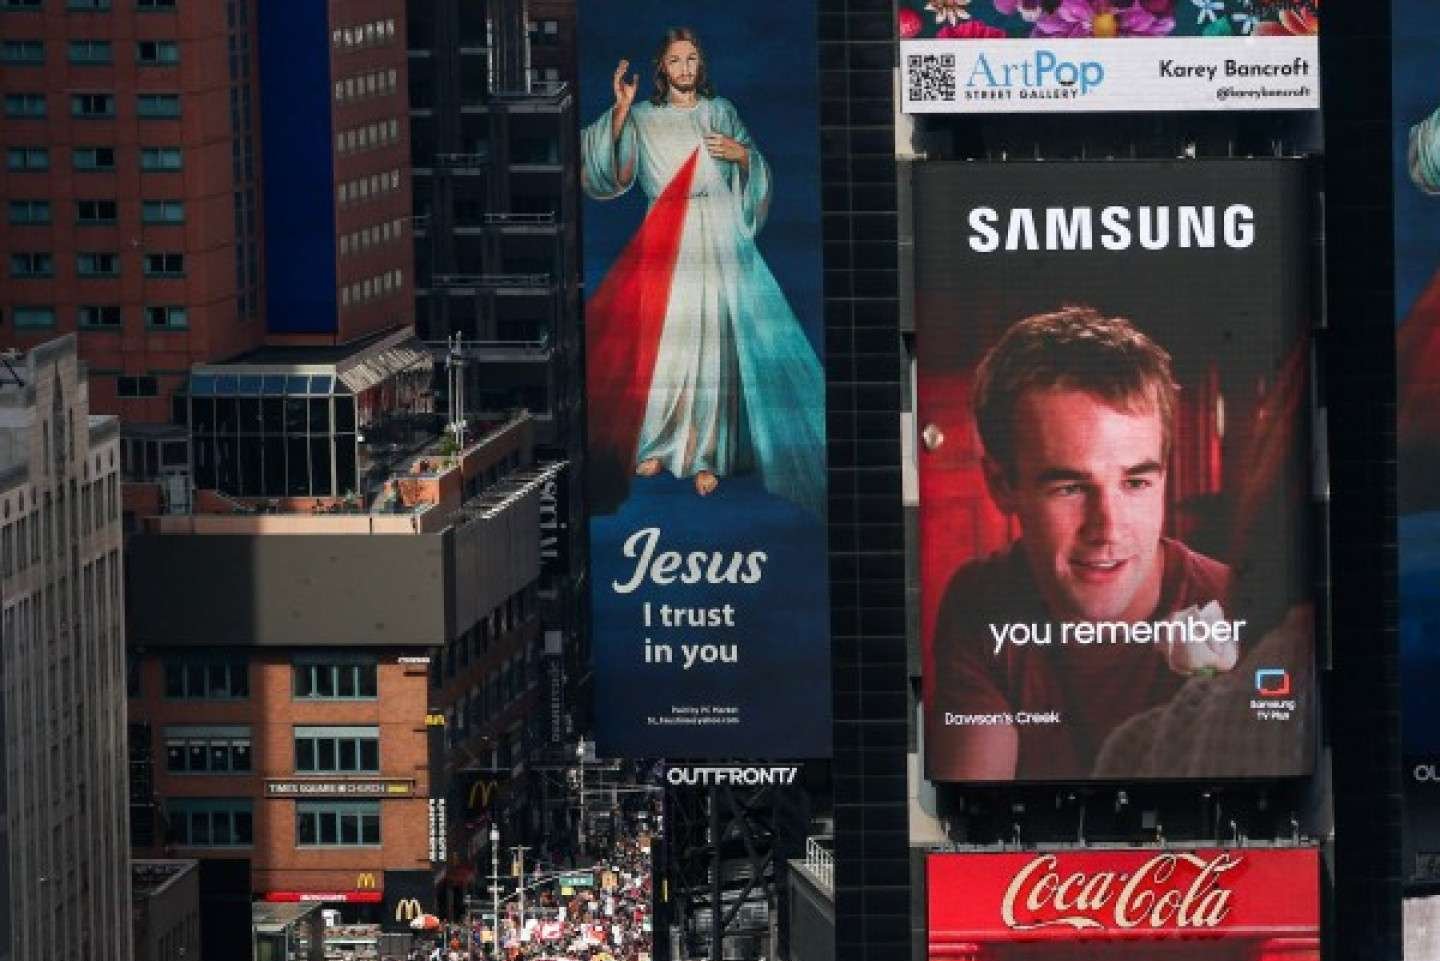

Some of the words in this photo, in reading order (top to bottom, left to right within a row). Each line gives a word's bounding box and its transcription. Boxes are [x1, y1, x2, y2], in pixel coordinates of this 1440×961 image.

[966, 50, 1104, 95] ArtPop
[1159, 60, 1217, 82] Karey
[1225, 58, 1309, 78] Bancroft
[965, 89, 1011, 100] STREET
[1019, 88, 1078, 100] GALLERY
[968, 203, 1255, 253] SAMSUNG
[612, 527, 768, 594] Jesus
[643, 602, 651, 628] I
[659, 604, 736, 628] trust
[989, 621, 1050, 654] you
[1060, 618, 1246, 646] remember
[645, 638, 673, 664] in
[681, 644, 738, 671] you
[1016, 711, 1060, 724] Creek
[1001, 852, 1243, 929] Coca-Cola
